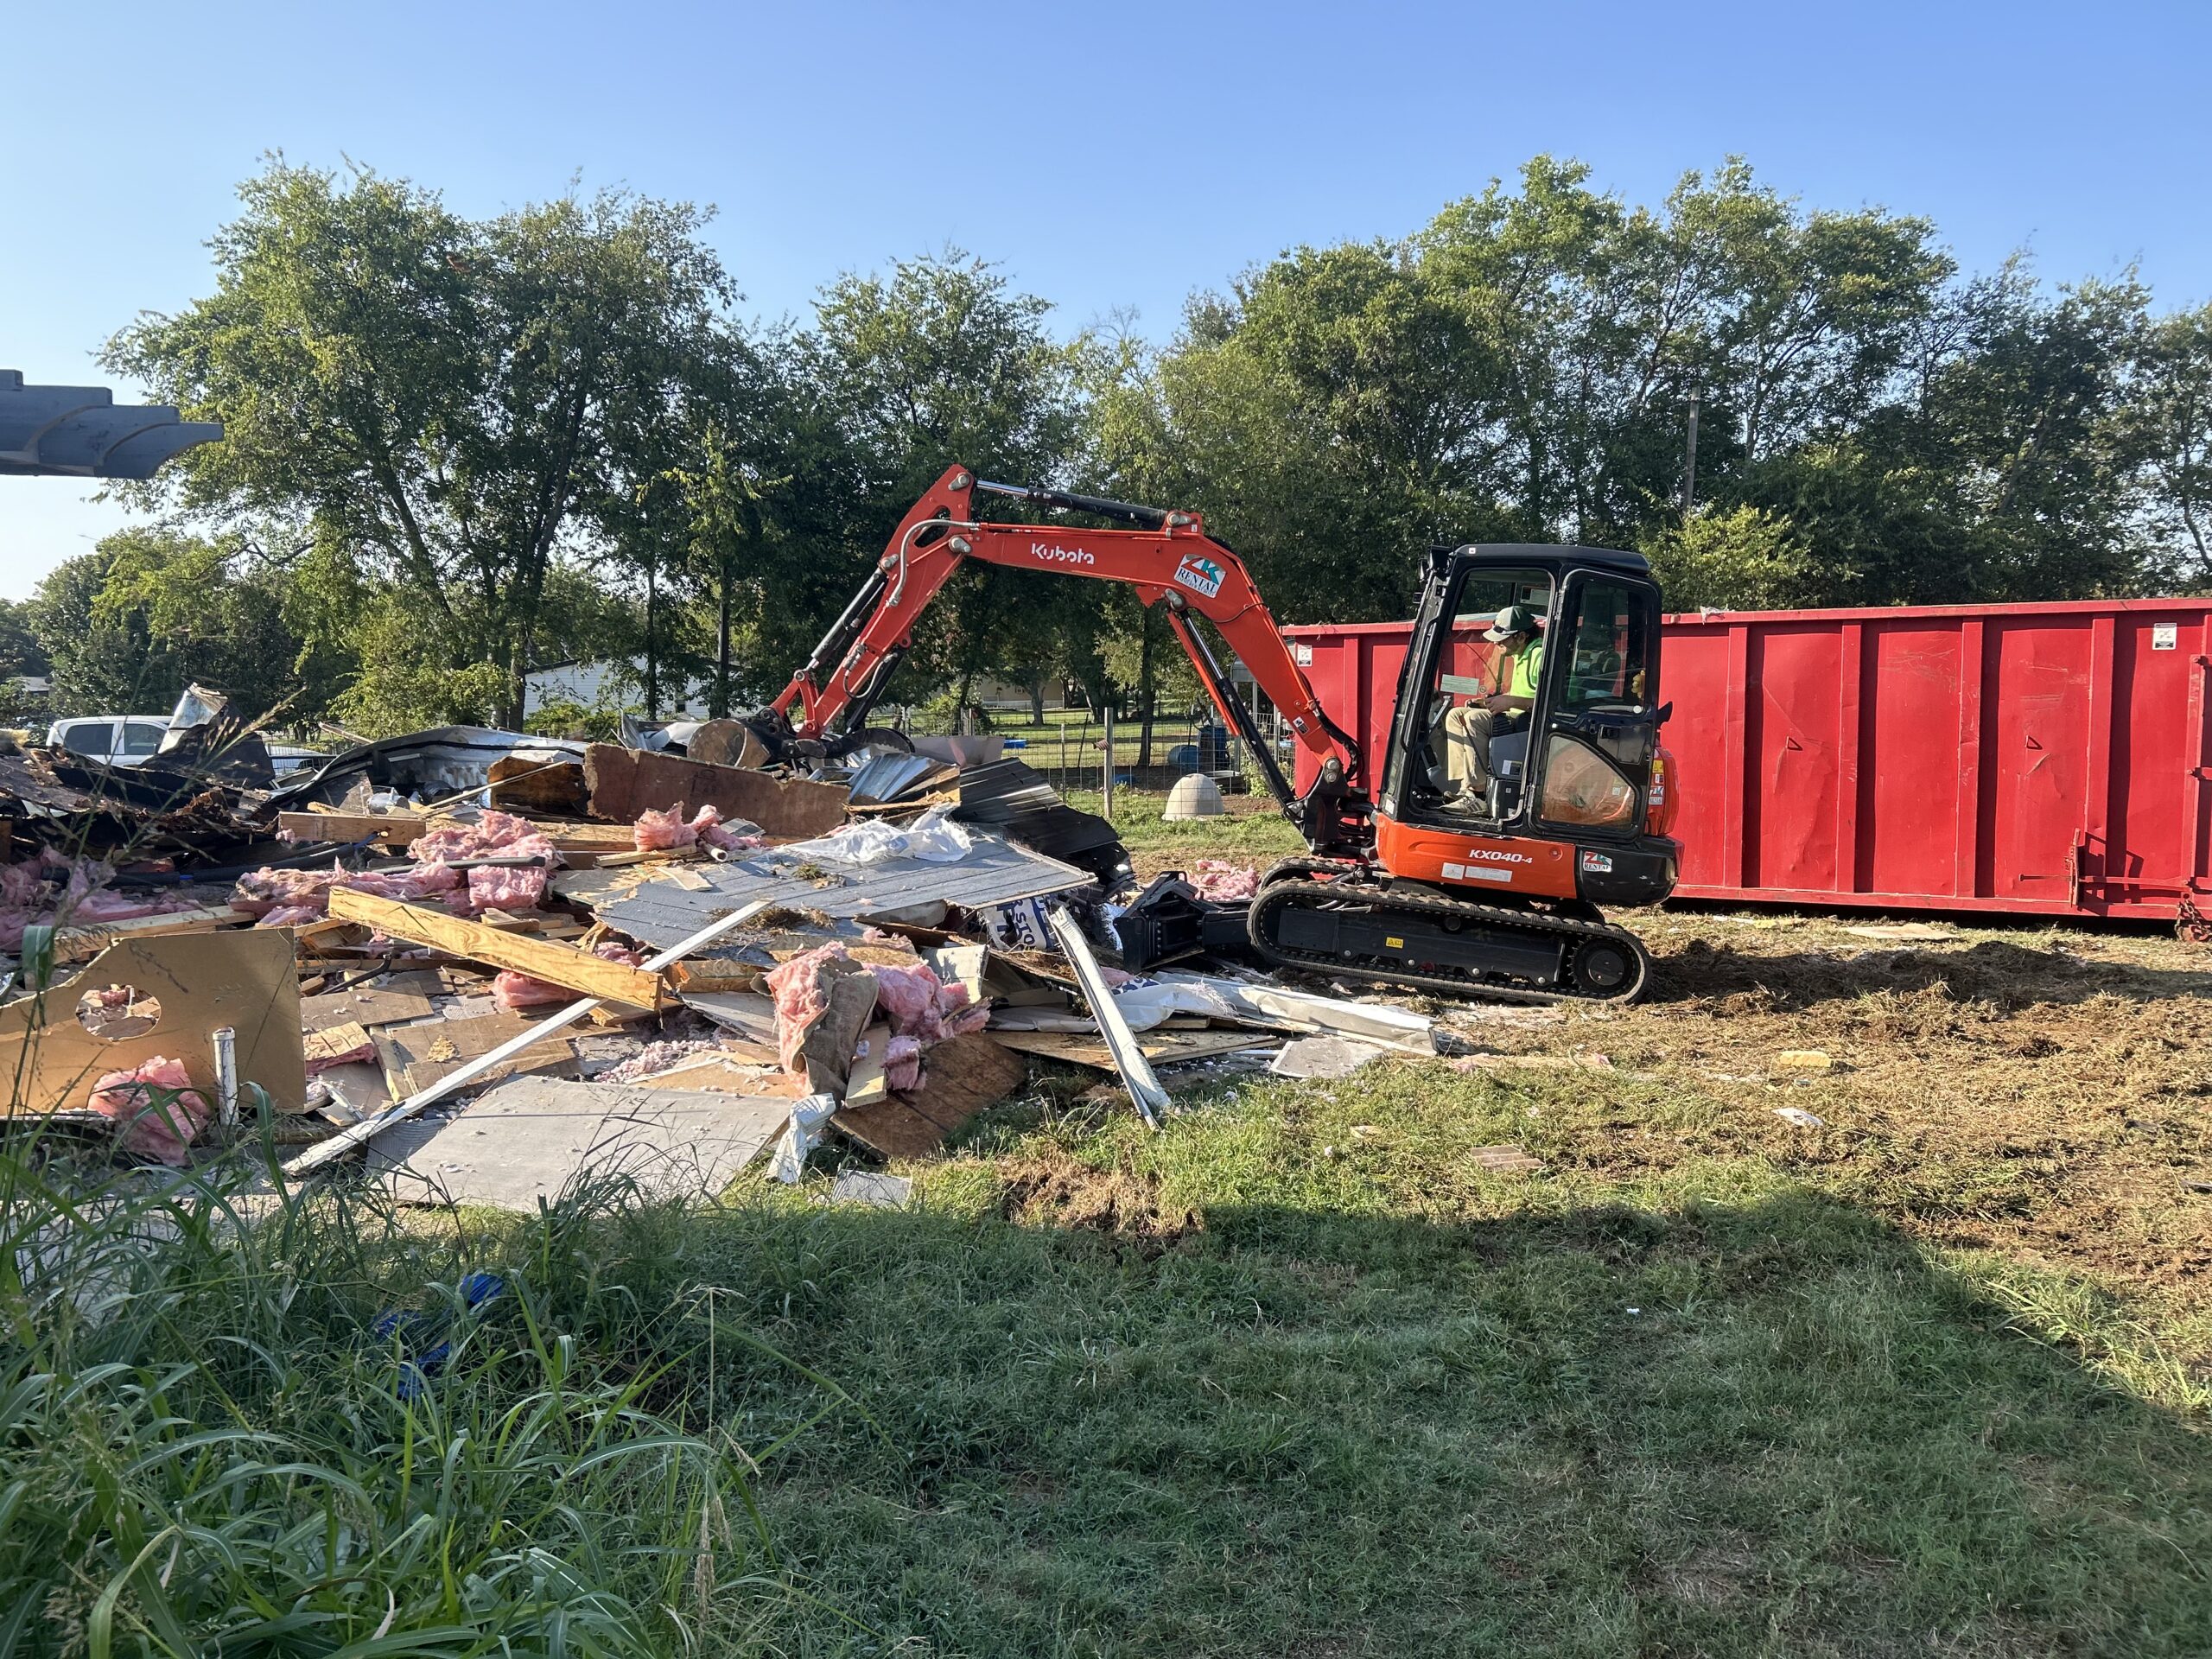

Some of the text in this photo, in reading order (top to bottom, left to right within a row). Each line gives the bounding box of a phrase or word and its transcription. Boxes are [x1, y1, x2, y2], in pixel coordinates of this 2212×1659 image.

[1031, 543, 1095, 565] Kubota
[1178, 568, 1216, 592] RENTAL
[1469, 849, 1533, 864] KX040-4
[1584, 852, 1611, 866] ZK
